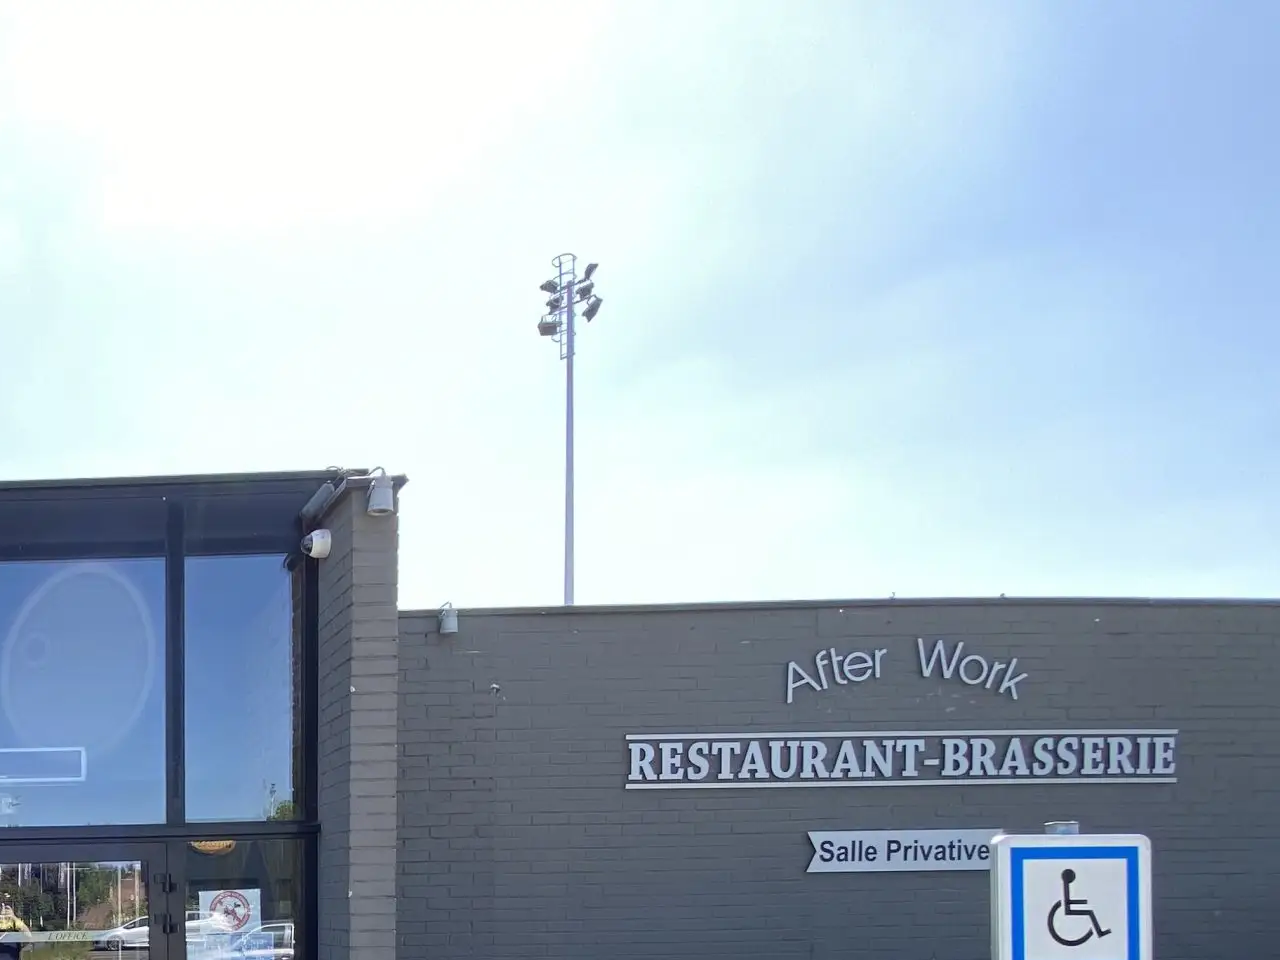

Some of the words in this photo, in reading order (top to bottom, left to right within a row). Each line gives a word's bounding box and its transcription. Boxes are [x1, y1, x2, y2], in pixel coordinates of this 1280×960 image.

[785, 646, 888, 704] After
[916, 638, 1029, 701] Work
[627, 735, 1177, 782] RESTAURANT-BRASSERIE
[818, 838, 878, 864] Salle
[885, 836, 990, 863] Privative
